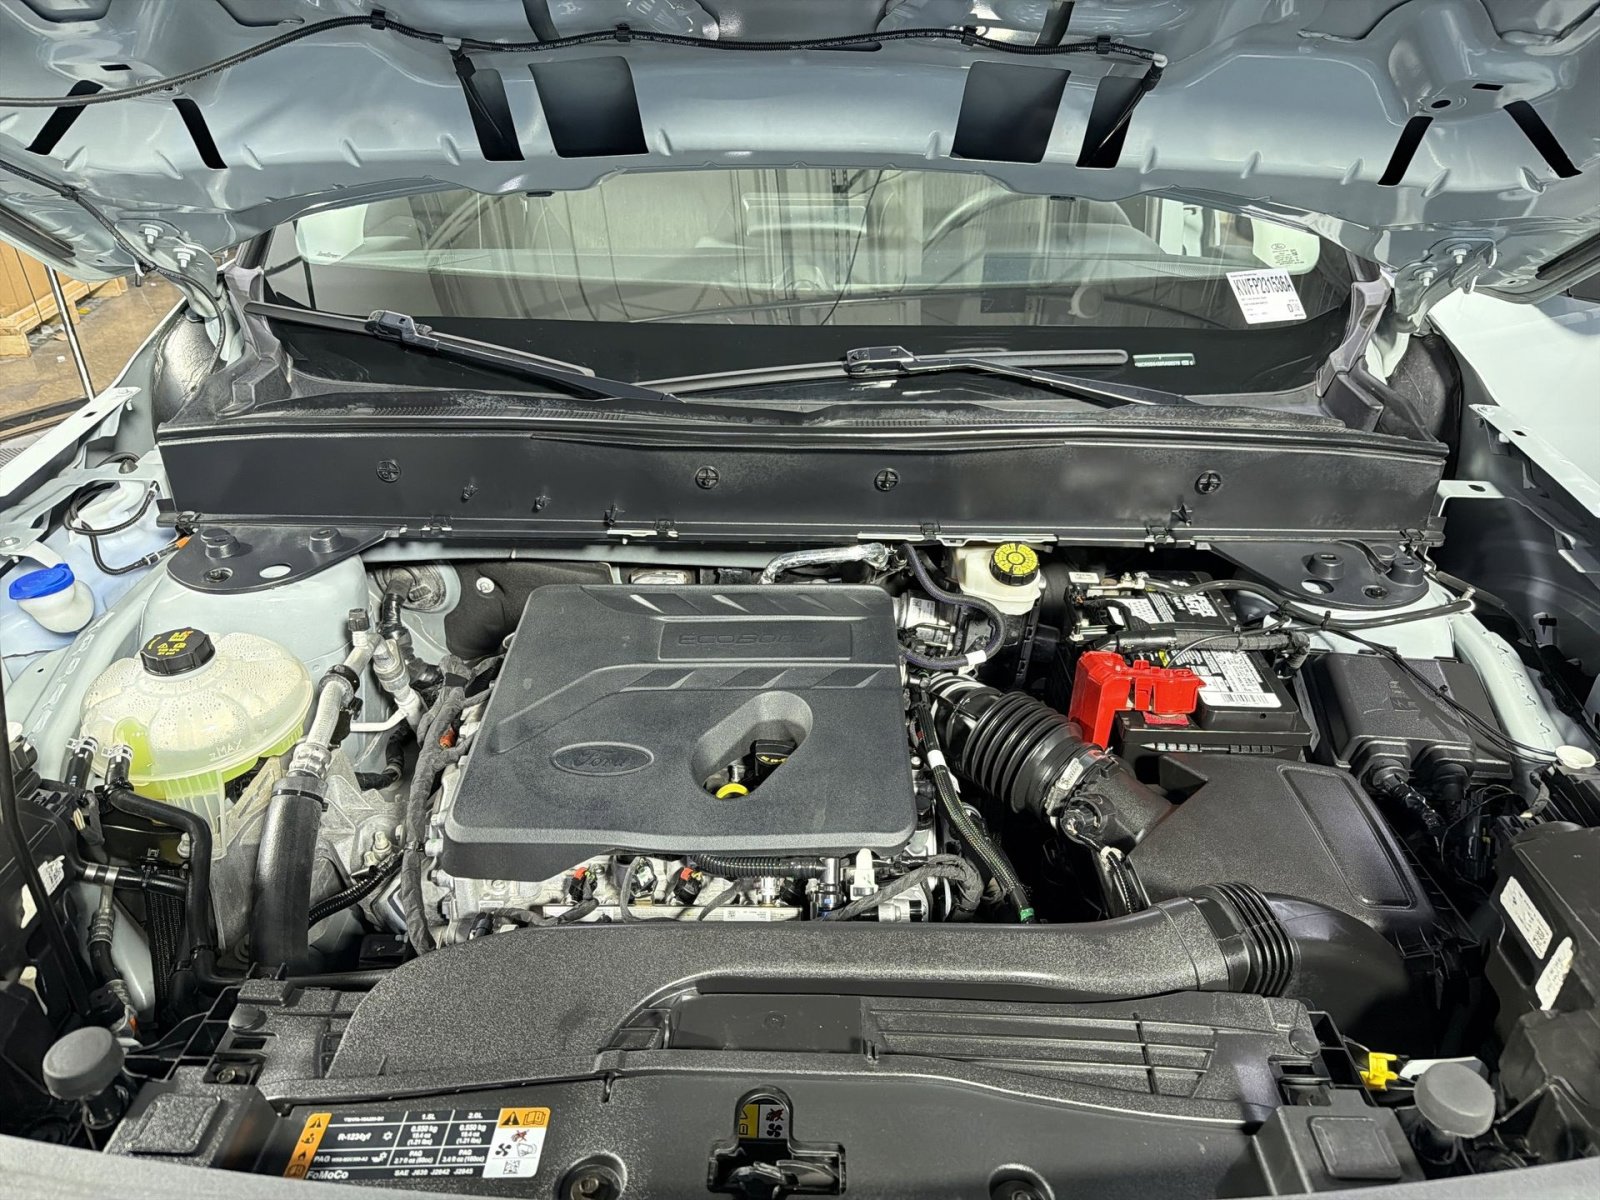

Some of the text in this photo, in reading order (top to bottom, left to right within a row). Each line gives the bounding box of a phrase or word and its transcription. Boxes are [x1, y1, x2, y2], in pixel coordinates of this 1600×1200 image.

[215, 738, 242, 757] MAX
[571, 748, 632, 768] Ford
[306, 1170, 349, 1179] FoMoCo
